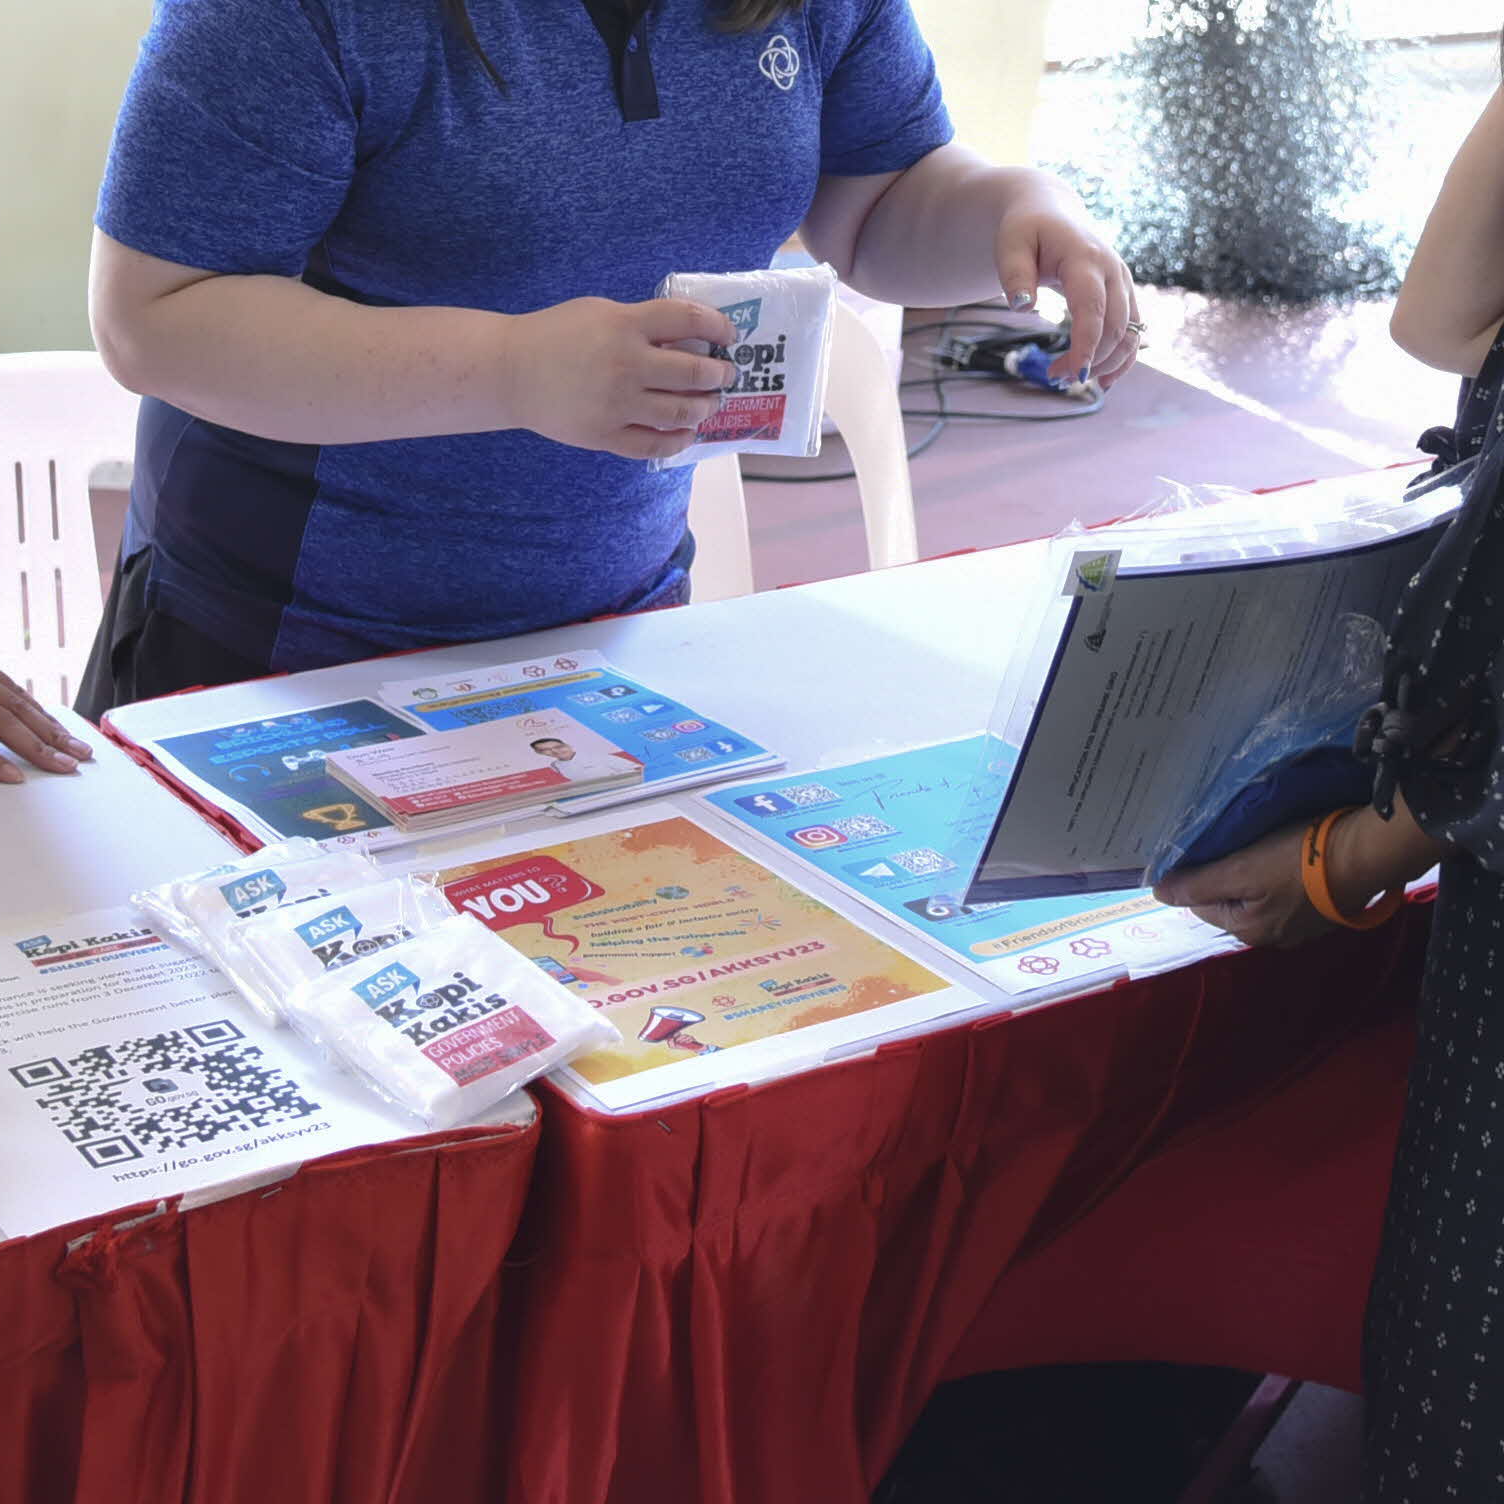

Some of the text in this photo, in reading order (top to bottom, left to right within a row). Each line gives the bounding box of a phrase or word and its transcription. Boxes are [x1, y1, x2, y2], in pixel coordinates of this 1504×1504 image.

[725, 305, 753, 326] SK
[234, 876, 276, 903] ASK
[308, 912, 351, 940] ASK
[365, 968, 408, 1000] ASK
[374, 972, 484, 1029] Kopi
[401, 992, 508, 1047] Kakis
[428, 1009, 521, 1059] GOVERNMENT
[440, 1036, 504, 1071] POLICIES
